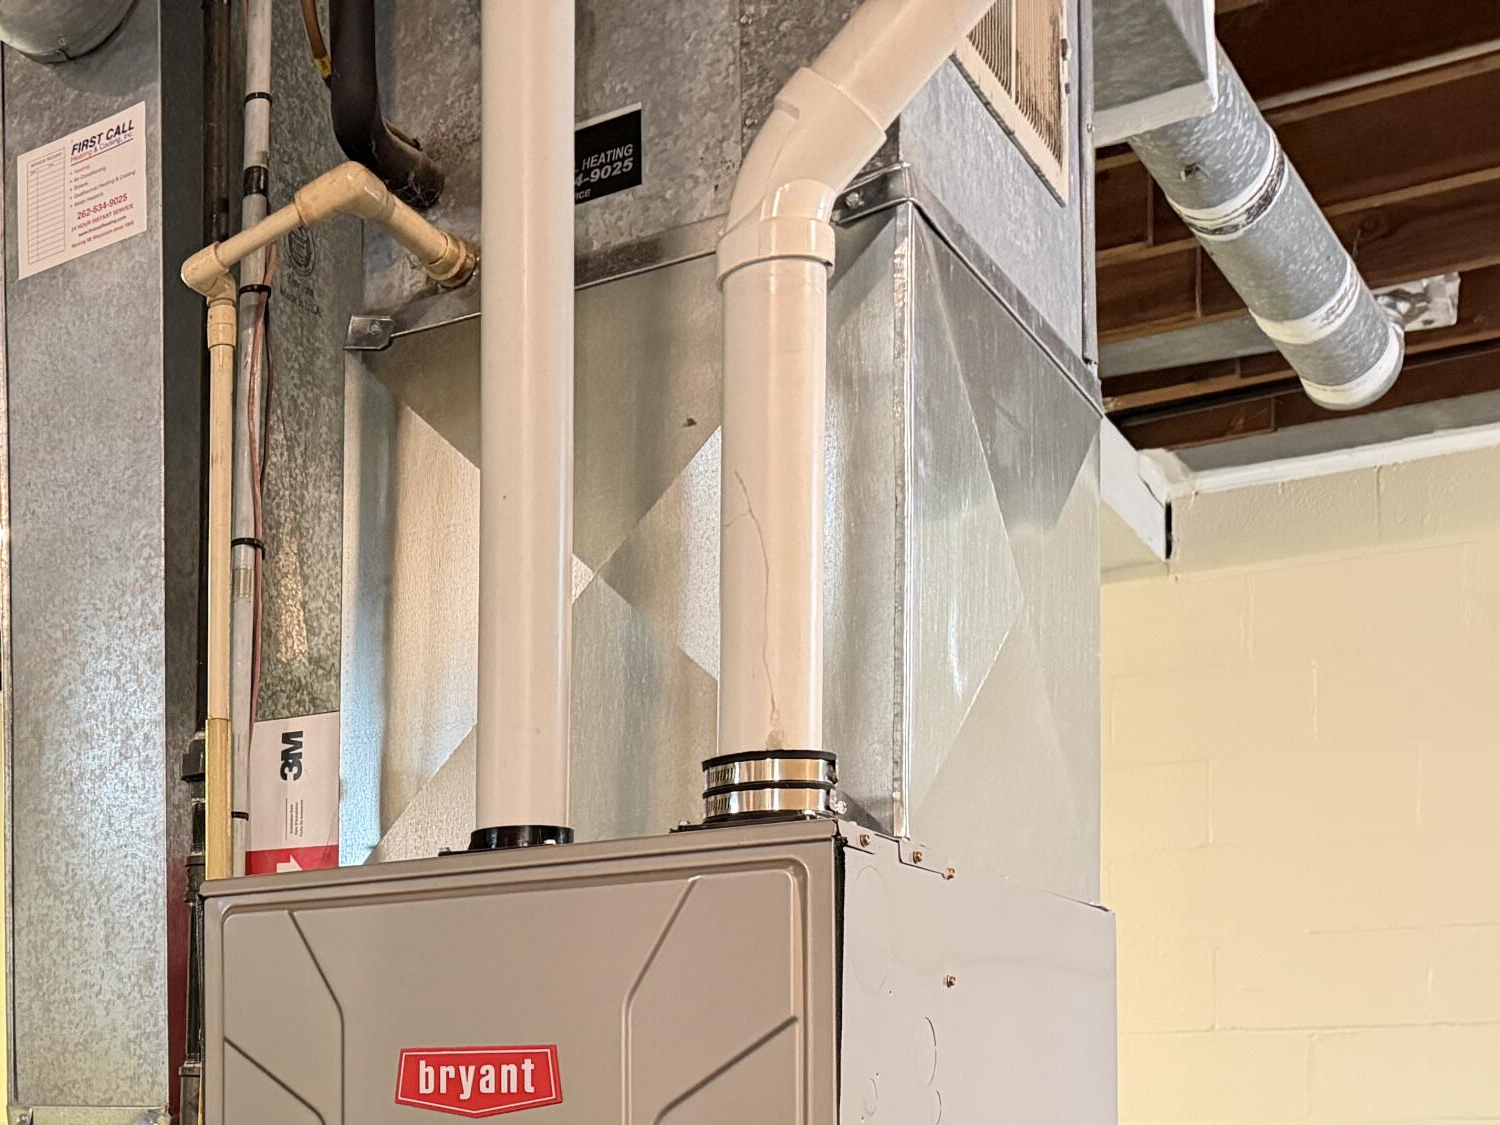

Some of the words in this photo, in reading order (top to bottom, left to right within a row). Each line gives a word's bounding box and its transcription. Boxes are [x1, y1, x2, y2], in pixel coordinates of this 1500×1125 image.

[72, 132, 104, 156] FIRST
[106, 120, 134, 140] CALL
[582, 144, 633, 170] HEATING
[280, 731, 303, 781] 3M
[419, 1058, 535, 1100] bryant
